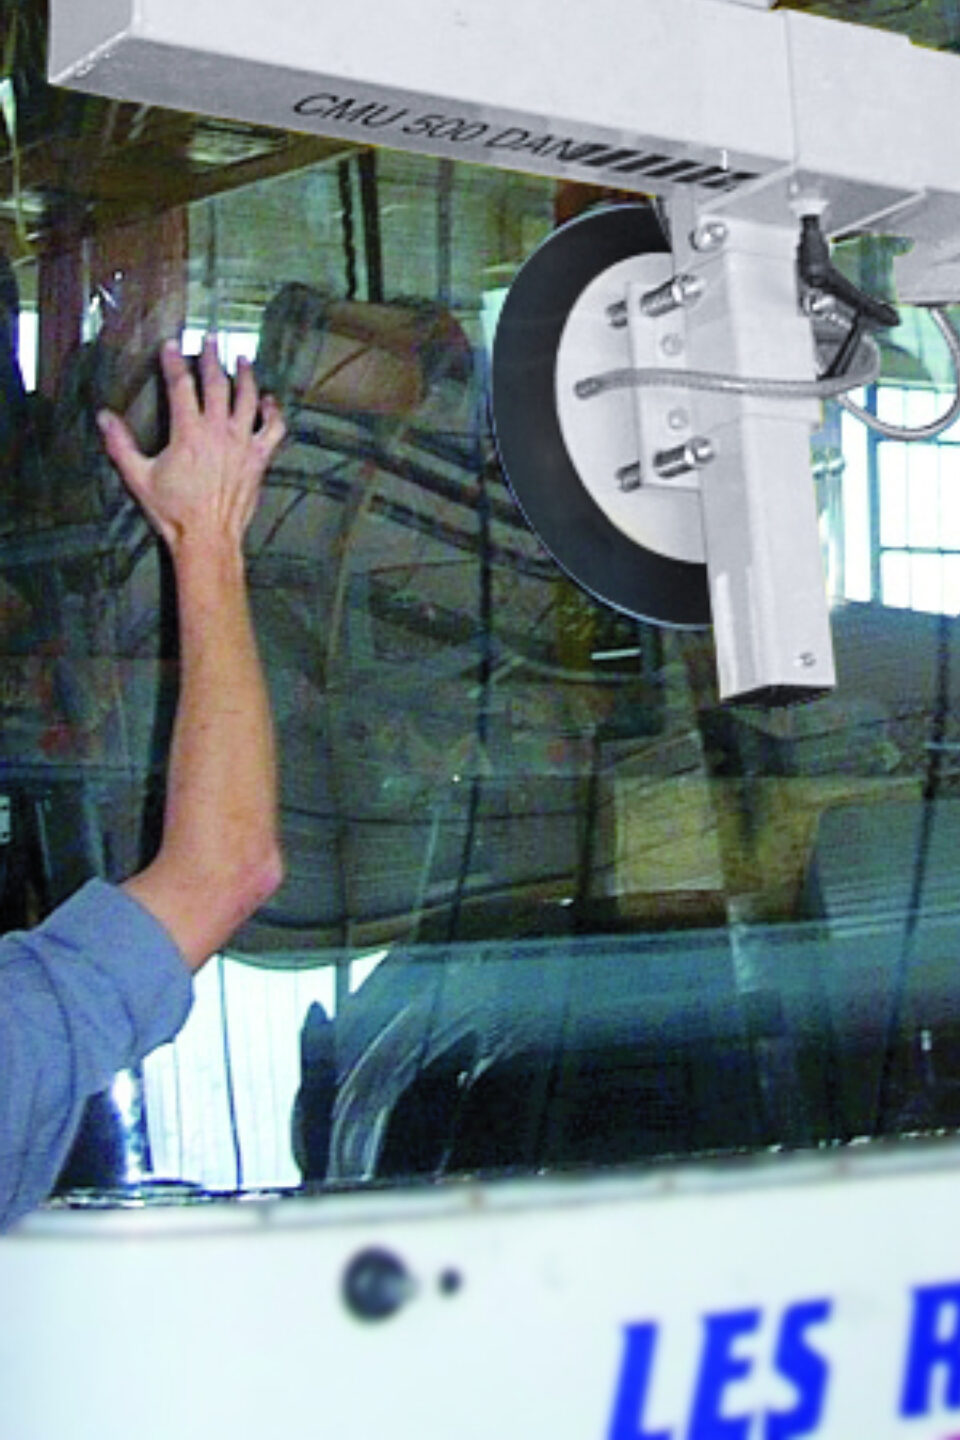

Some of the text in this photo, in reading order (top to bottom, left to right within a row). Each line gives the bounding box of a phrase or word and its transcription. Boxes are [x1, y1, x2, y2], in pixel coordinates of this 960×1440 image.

[293, 92, 588, 161] CMU 500 DAN
[605, 1297, 834, 1440] LES
